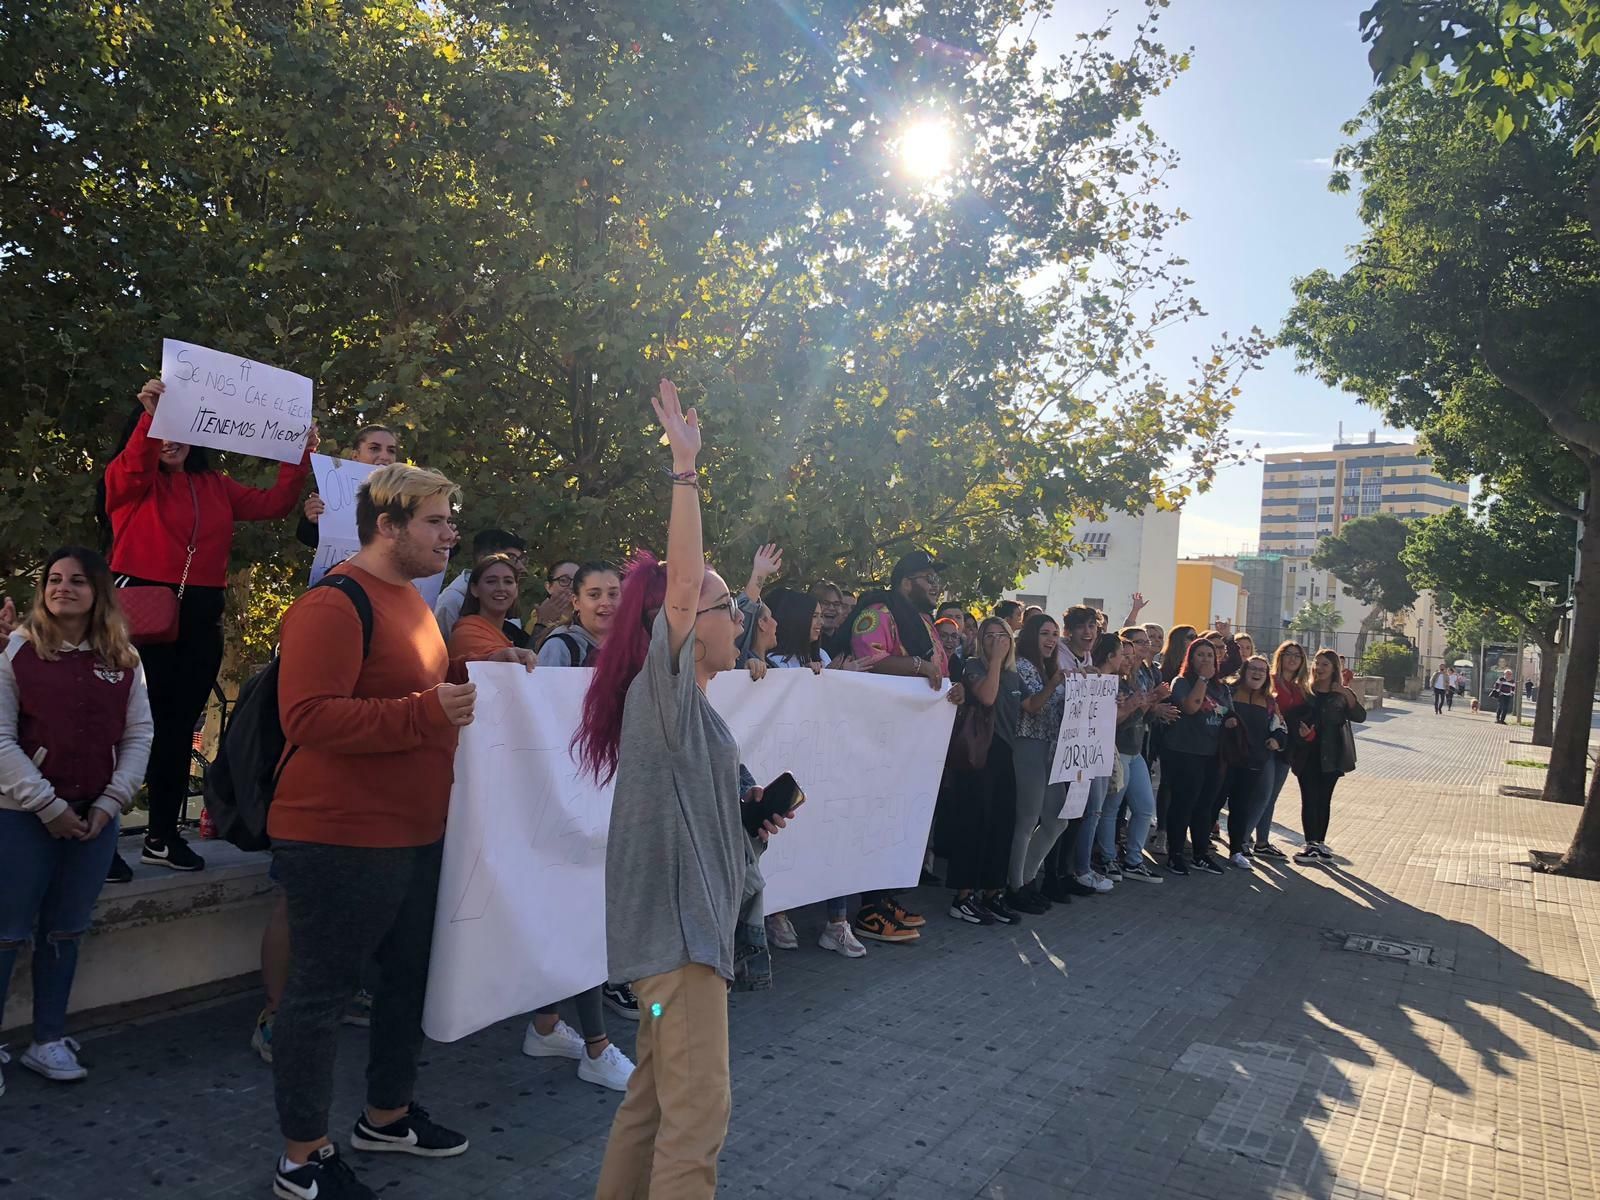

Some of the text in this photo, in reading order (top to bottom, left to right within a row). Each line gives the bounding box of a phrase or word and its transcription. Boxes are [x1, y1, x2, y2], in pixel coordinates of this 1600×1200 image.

[205, 371, 237, 397] NOS
[245, 385, 268, 407] CAE
[273, 397, 284, 411] EL
